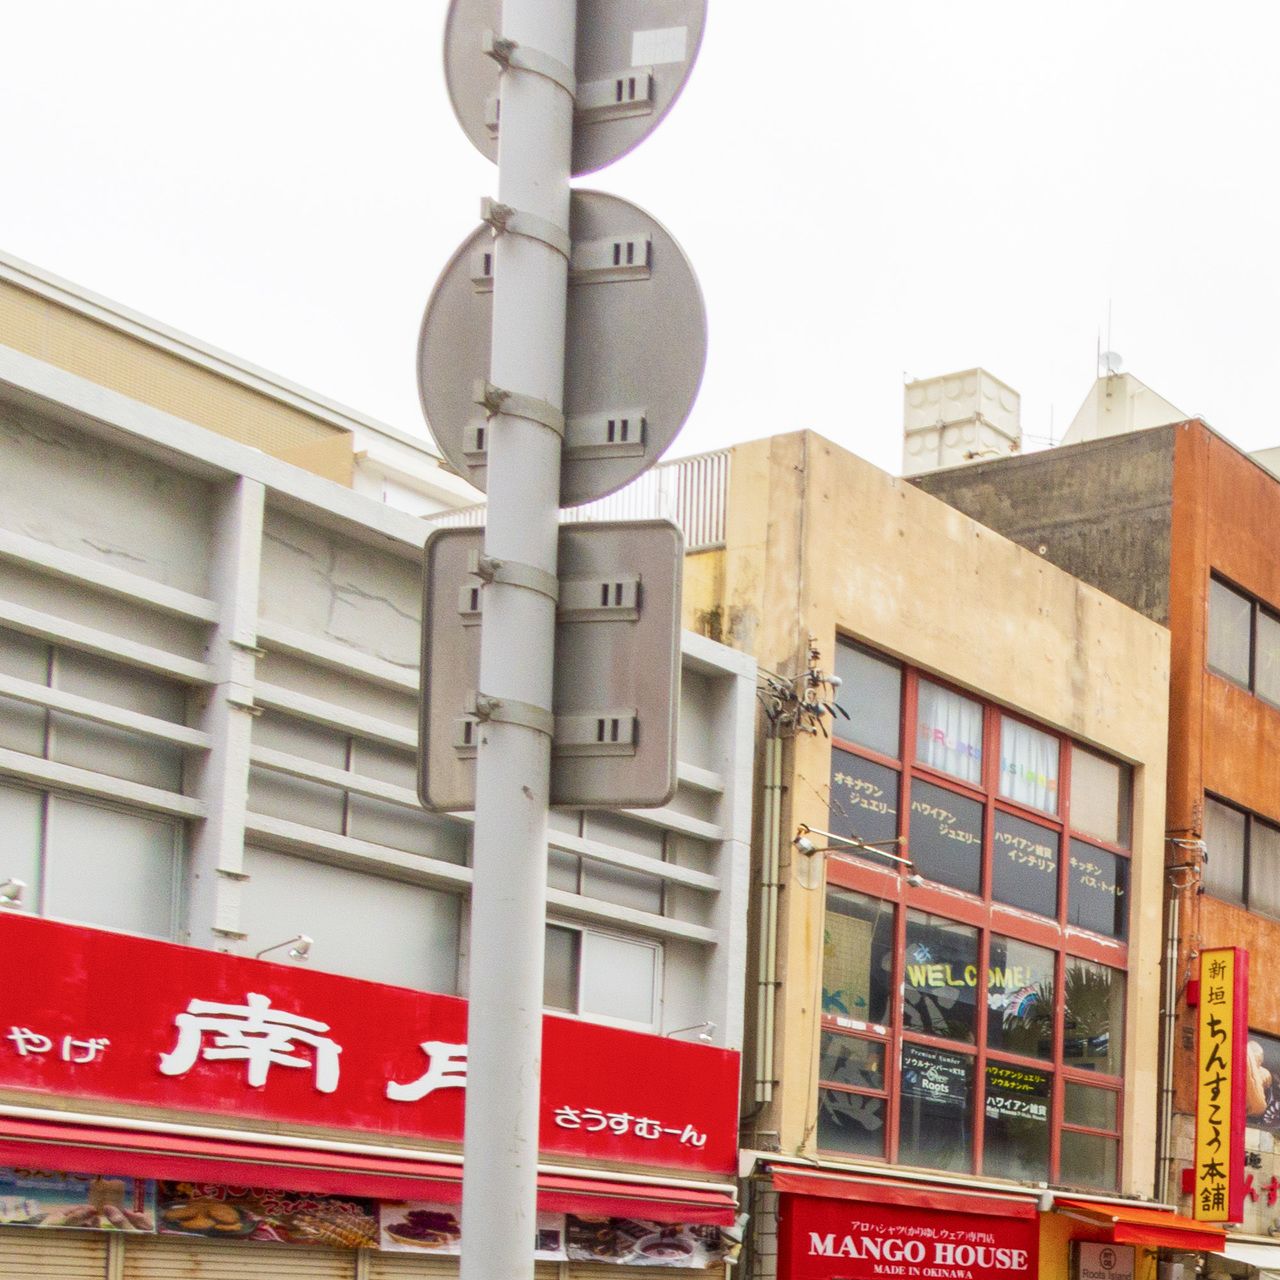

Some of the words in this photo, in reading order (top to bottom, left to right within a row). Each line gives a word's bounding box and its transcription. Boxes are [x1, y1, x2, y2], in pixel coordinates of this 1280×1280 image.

[834, 772, 883, 797] オキナワン
[849, 792, 897, 814] ジュエリー
[911, 801, 956, 824] ハワイアン
[938, 823, 981, 844] ジュエリー
[1007, 849, 1056, 873] インテリア
[1069, 857, 1102, 876] キッチン
[555, 1105, 707, 1148] さうすむーん
[808, 1231, 926, 1264] MANGO
[934, 1242, 1029, 1271] HOUSE
[873, 1263, 906, 1276] MADE
[908, 1266, 921, 1277] IN
[922, 1267, 973, 1280] OKINAWA
[1082, 1268, 1106, 1280] Roots
[1108, 1271, 1132, 1280] Island
